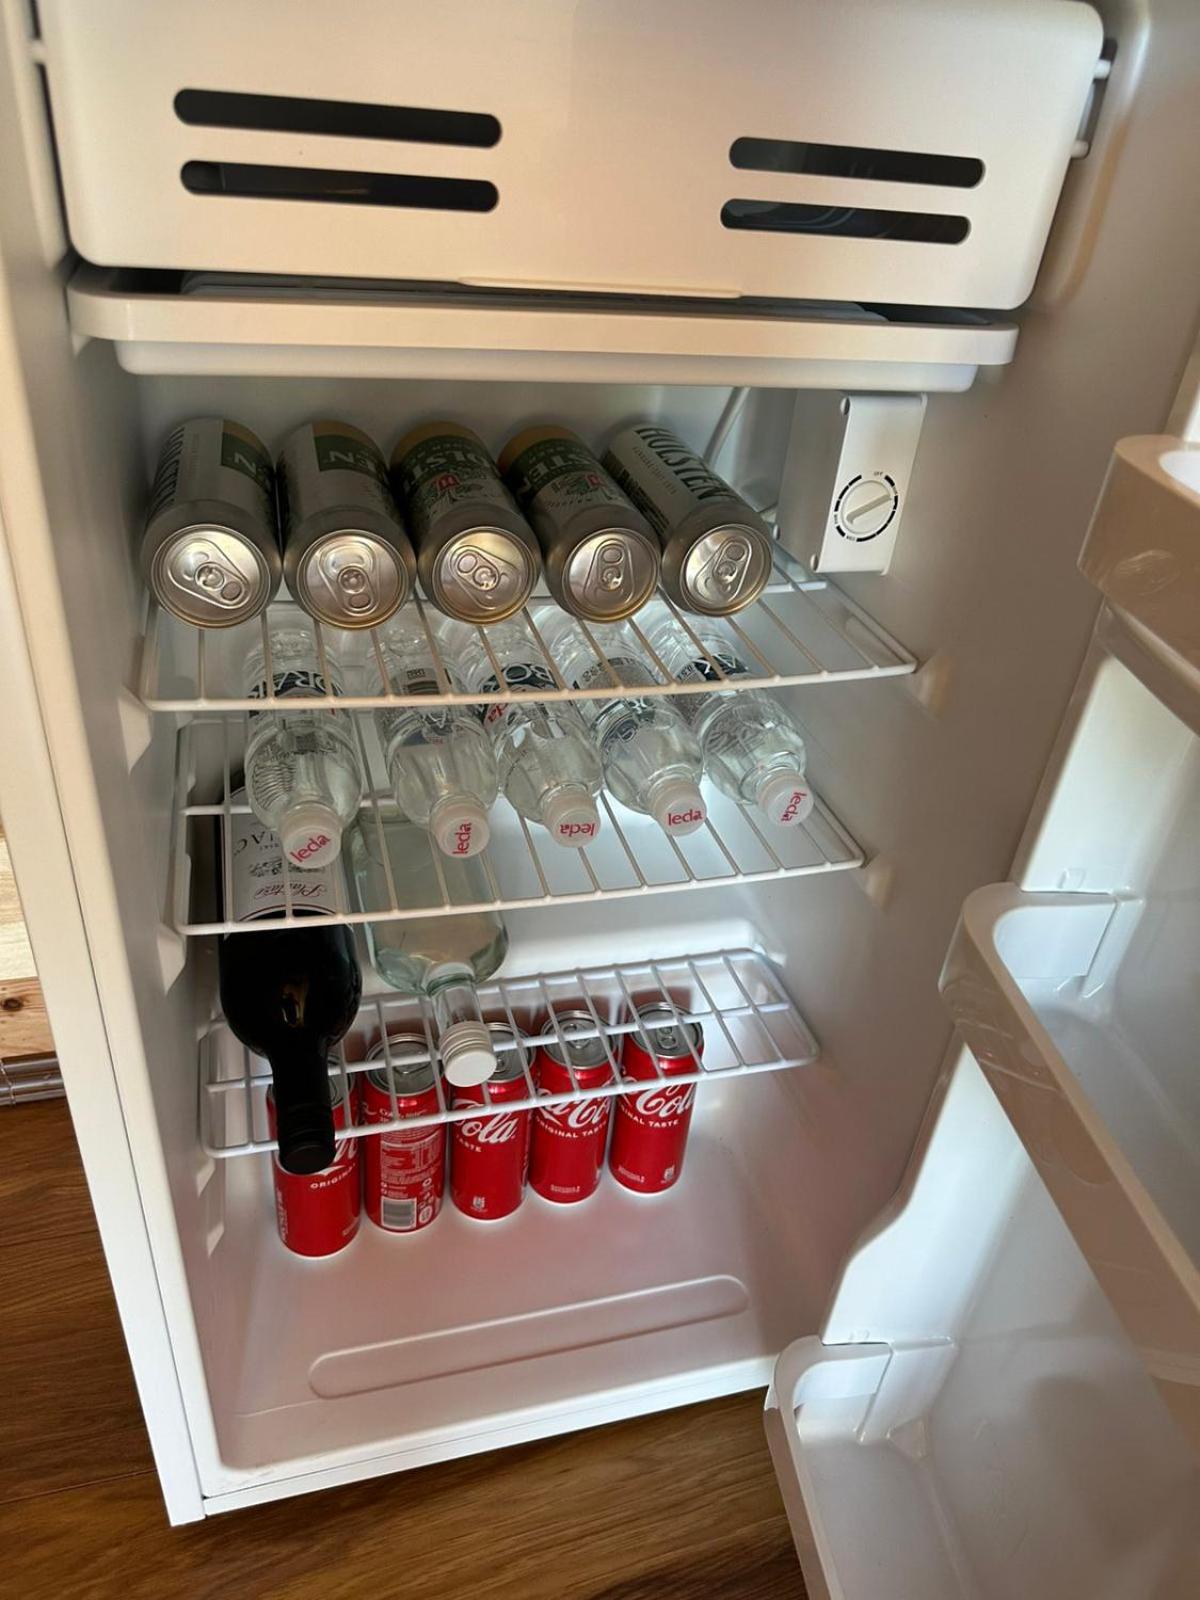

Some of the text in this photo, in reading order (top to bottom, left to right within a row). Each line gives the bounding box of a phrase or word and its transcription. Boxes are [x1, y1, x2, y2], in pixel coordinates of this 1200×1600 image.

[634, 427, 743, 501] HOLSTEN
[667, 810, 703, 826] leda
[781, 791, 807, 822] leda
[453, 822, 473, 855] leda
[559, 822, 596, 837] leda
[289, 834, 331, 863] leda
